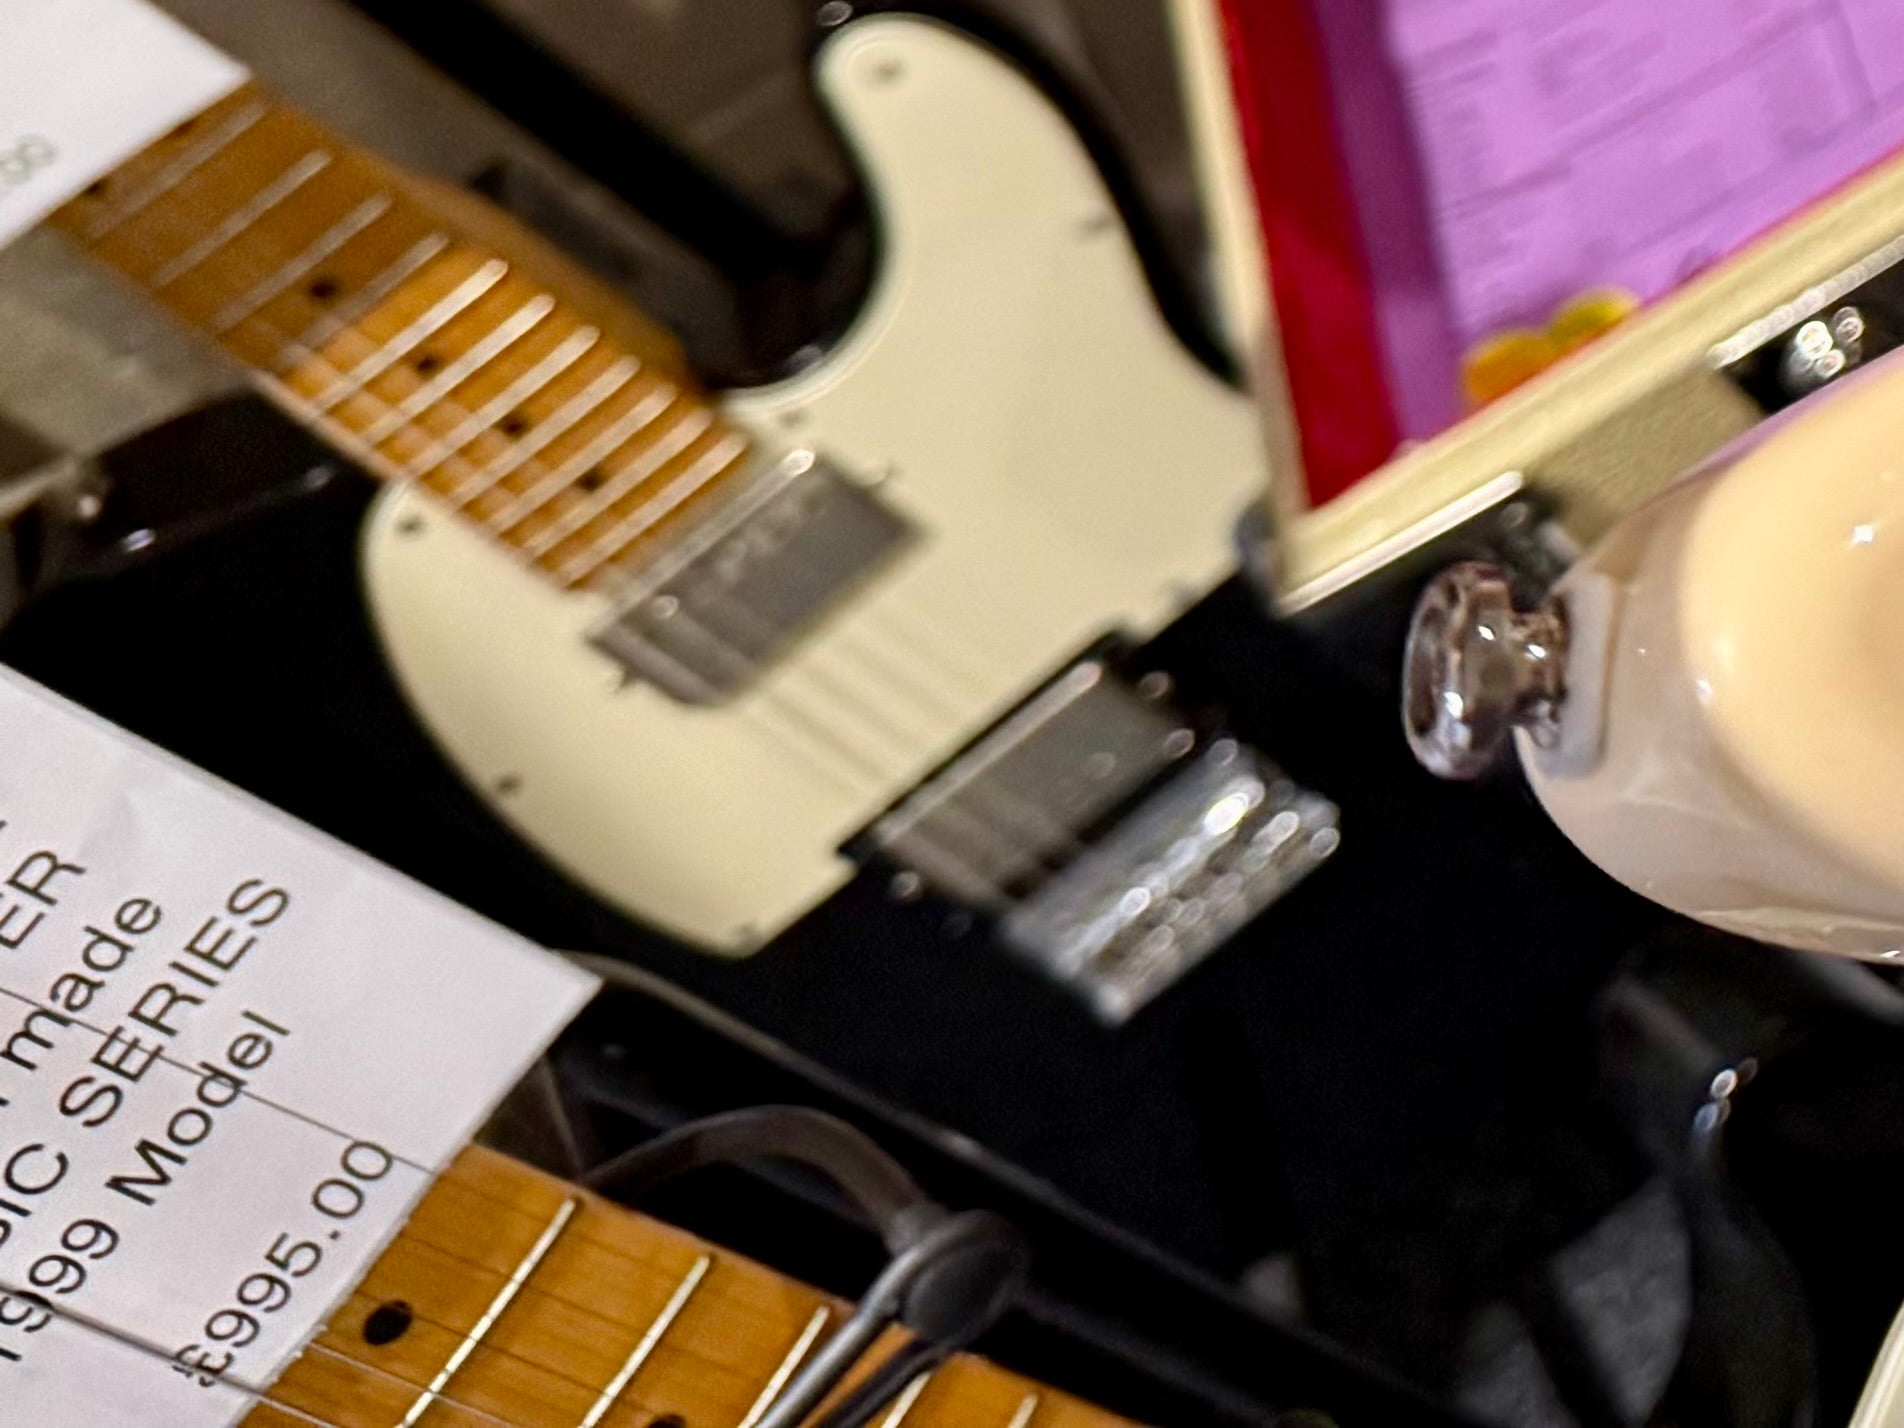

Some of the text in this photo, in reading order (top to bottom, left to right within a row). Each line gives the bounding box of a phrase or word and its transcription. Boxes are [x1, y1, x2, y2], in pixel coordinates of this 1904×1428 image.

[0, 896, 162, 1072] made
[60, 877, 291, 1129] SERIES
[105, 1009, 292, 1207] Model
[172, 1139, 395, 1390] £995.00
